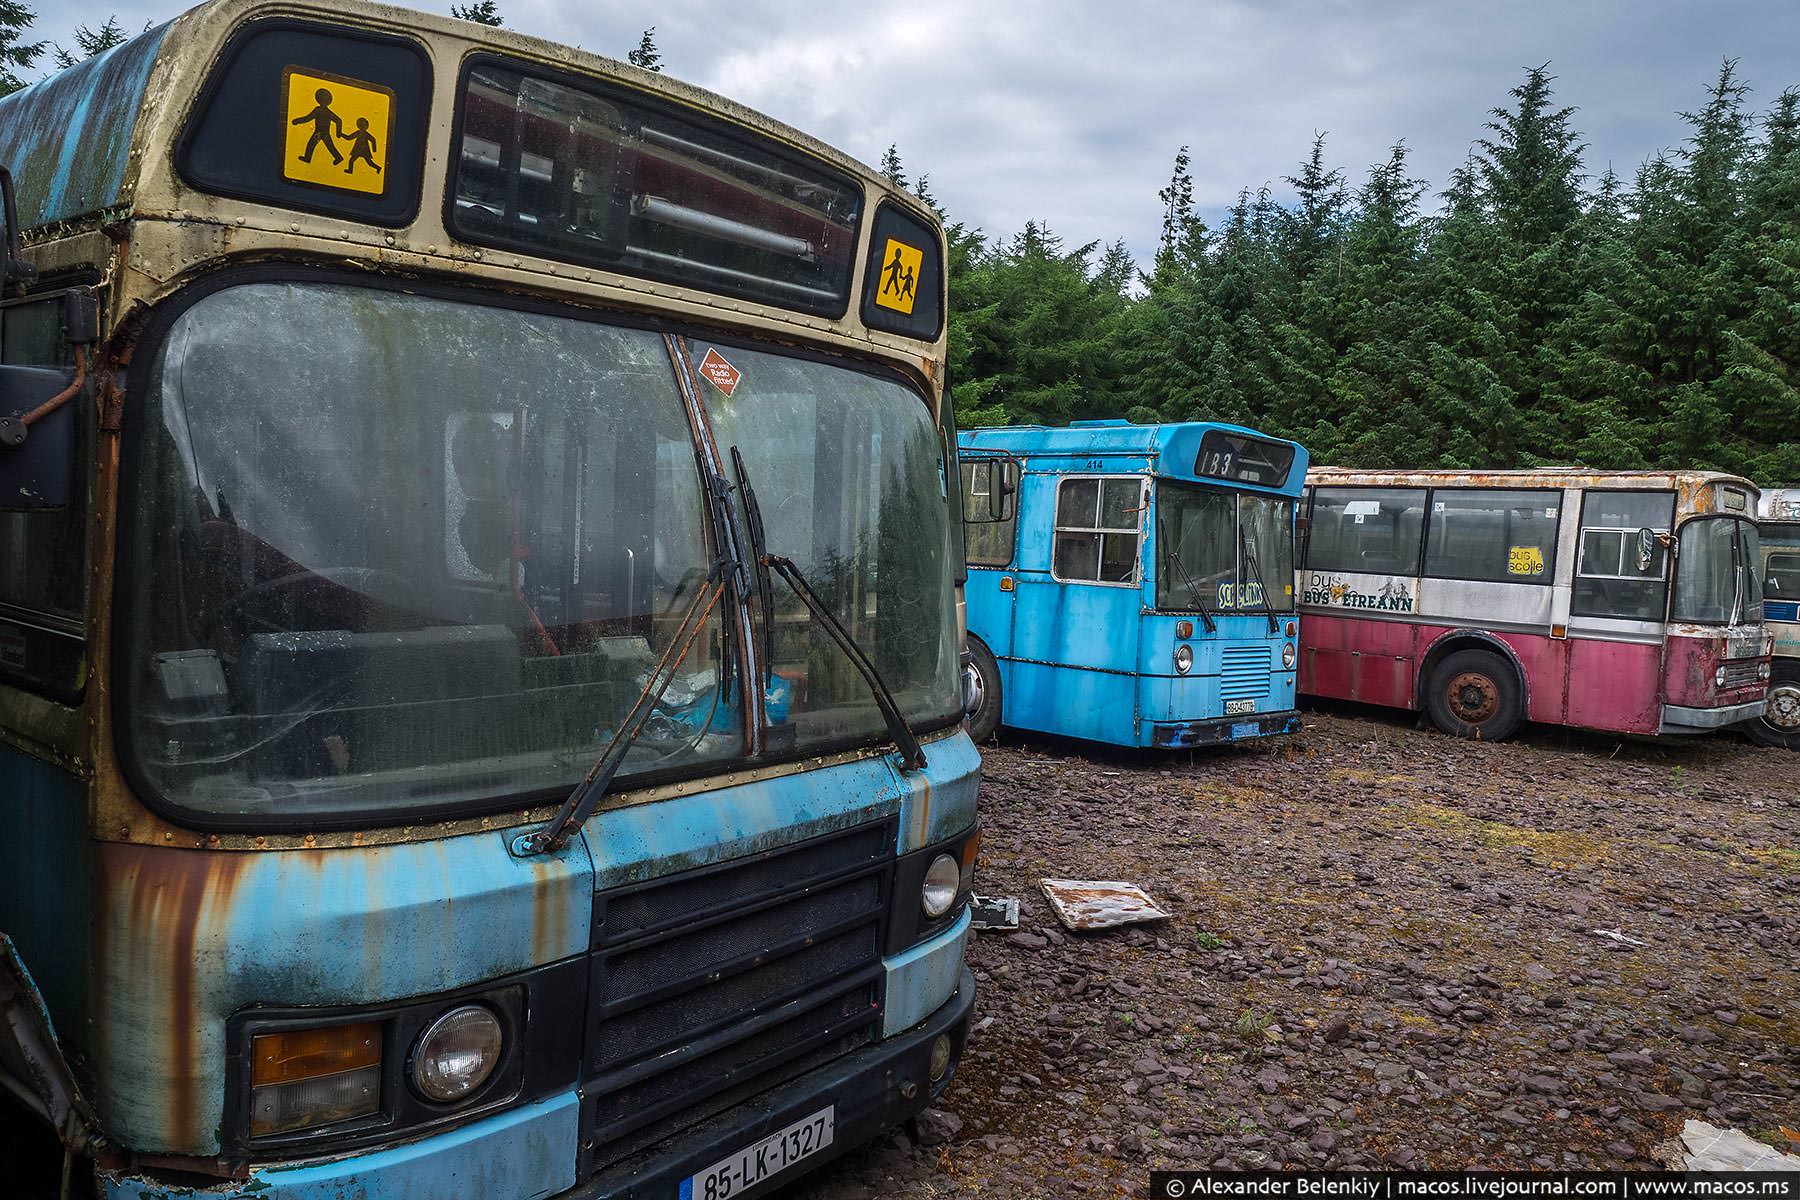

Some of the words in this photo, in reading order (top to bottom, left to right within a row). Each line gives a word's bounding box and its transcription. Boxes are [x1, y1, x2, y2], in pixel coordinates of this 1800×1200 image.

[711, 369, 730, 377] Radio
[1087, 460, 1103, 470] 414
[1201, 451, 1232, 475] 183
[1510, 550, 1531, 561] bus
[1303, 590, 1330, 605] BUS
[704, 1116, 826, 1200] 85-LK-1327
